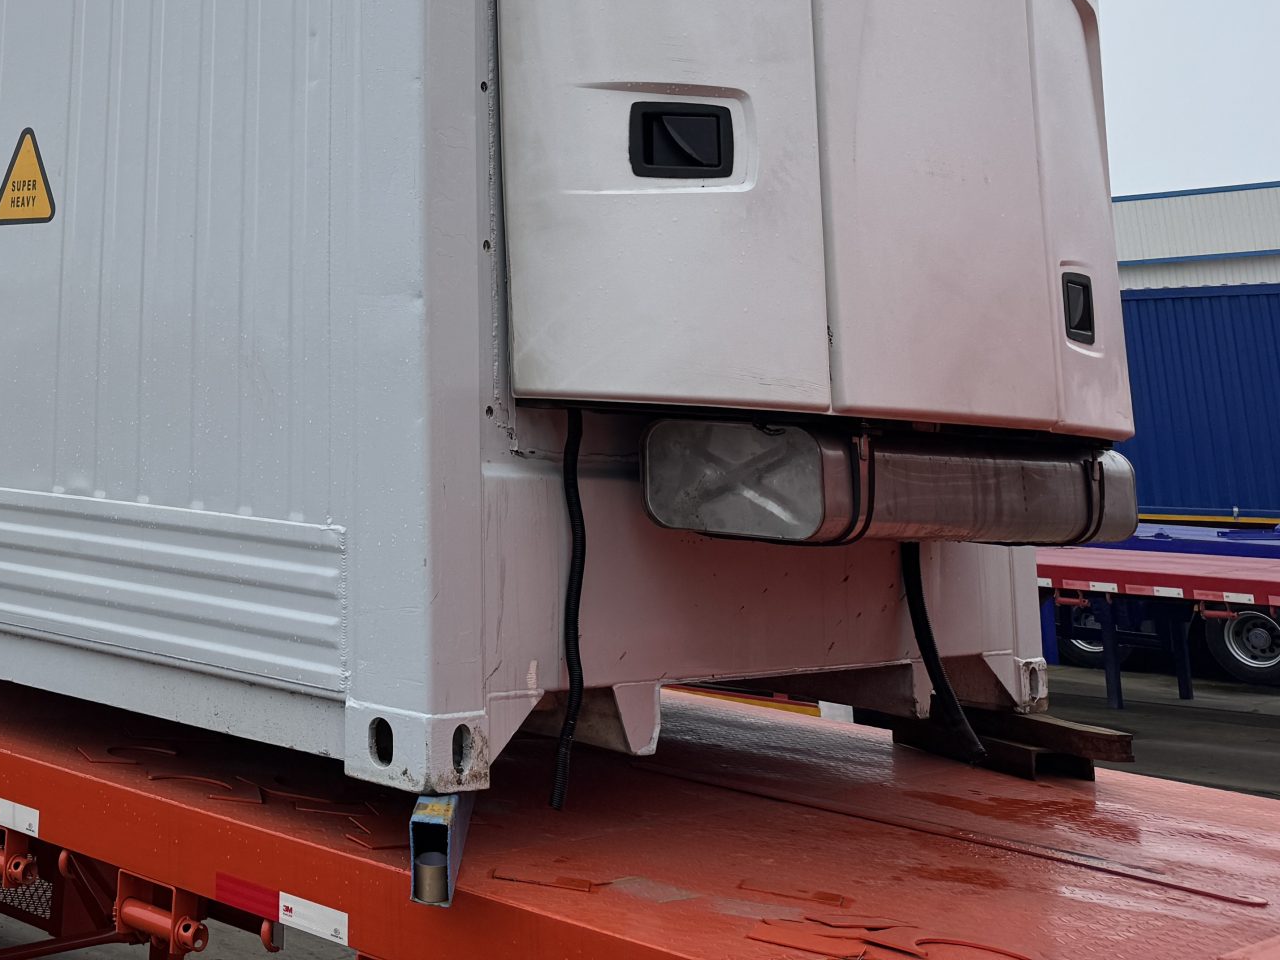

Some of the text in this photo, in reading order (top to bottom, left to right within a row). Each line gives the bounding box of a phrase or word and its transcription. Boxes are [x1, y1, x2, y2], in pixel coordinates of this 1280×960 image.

[11, 179, 37, 192] SUPER
[10, 195, 37, 208] HEAVY
[282, 904, 293, 914] 3M
